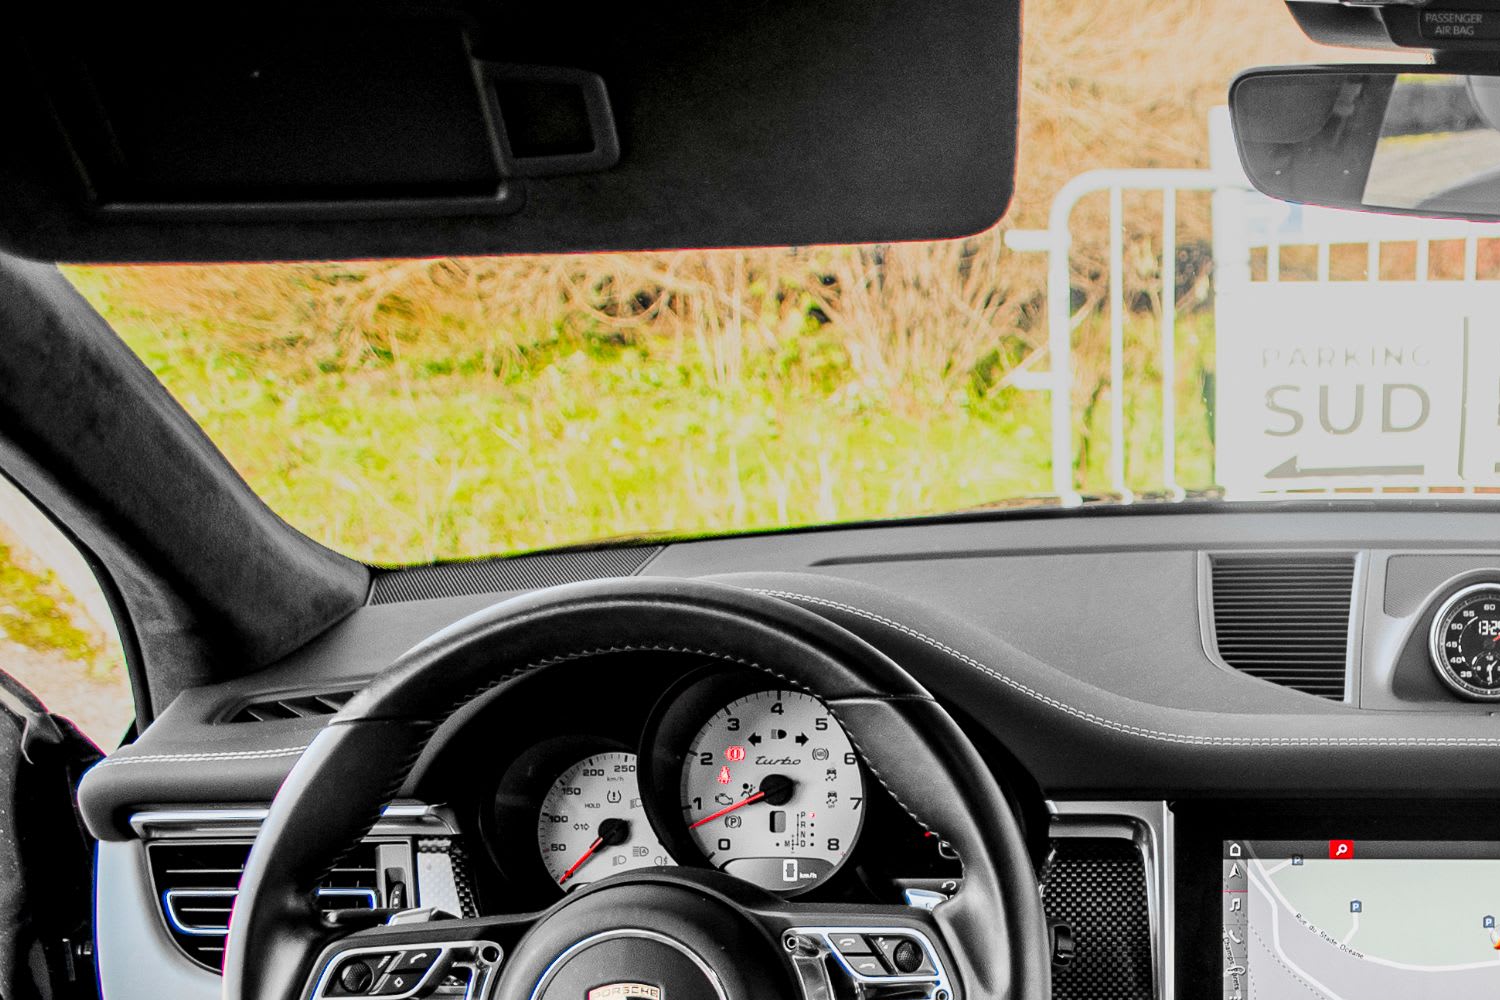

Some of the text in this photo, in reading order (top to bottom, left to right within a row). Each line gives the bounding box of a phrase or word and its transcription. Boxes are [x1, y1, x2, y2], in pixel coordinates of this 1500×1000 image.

[1424, 13, 1483, 24] PASSENGER
[1434, 25, 1475, 35] AIR BAG
[1262, 345, 1431, 368] PARKING
[1264, 383, 1431, 437] SUD
[771, 702, 784, 715] 4
[727, 718, 740, 731] 3
[815, 718, 828, 731] 5
[701, 752, 713, 765] 2
[755, 755, 801, 765] turbo
[844, 752, 856, 765] 6
[562, 787, 581, 795] 150
[693, 797, 702, 810] 1
[850, 797, 862, 810] 7
[550, 815, 568, 823] 100
[718, 838, 731, 850] 0
[827, 838, 840, 850] 8
[1320, 931, 1338, 945] Stade
[592, 986, 659, 998] PORSCHE
